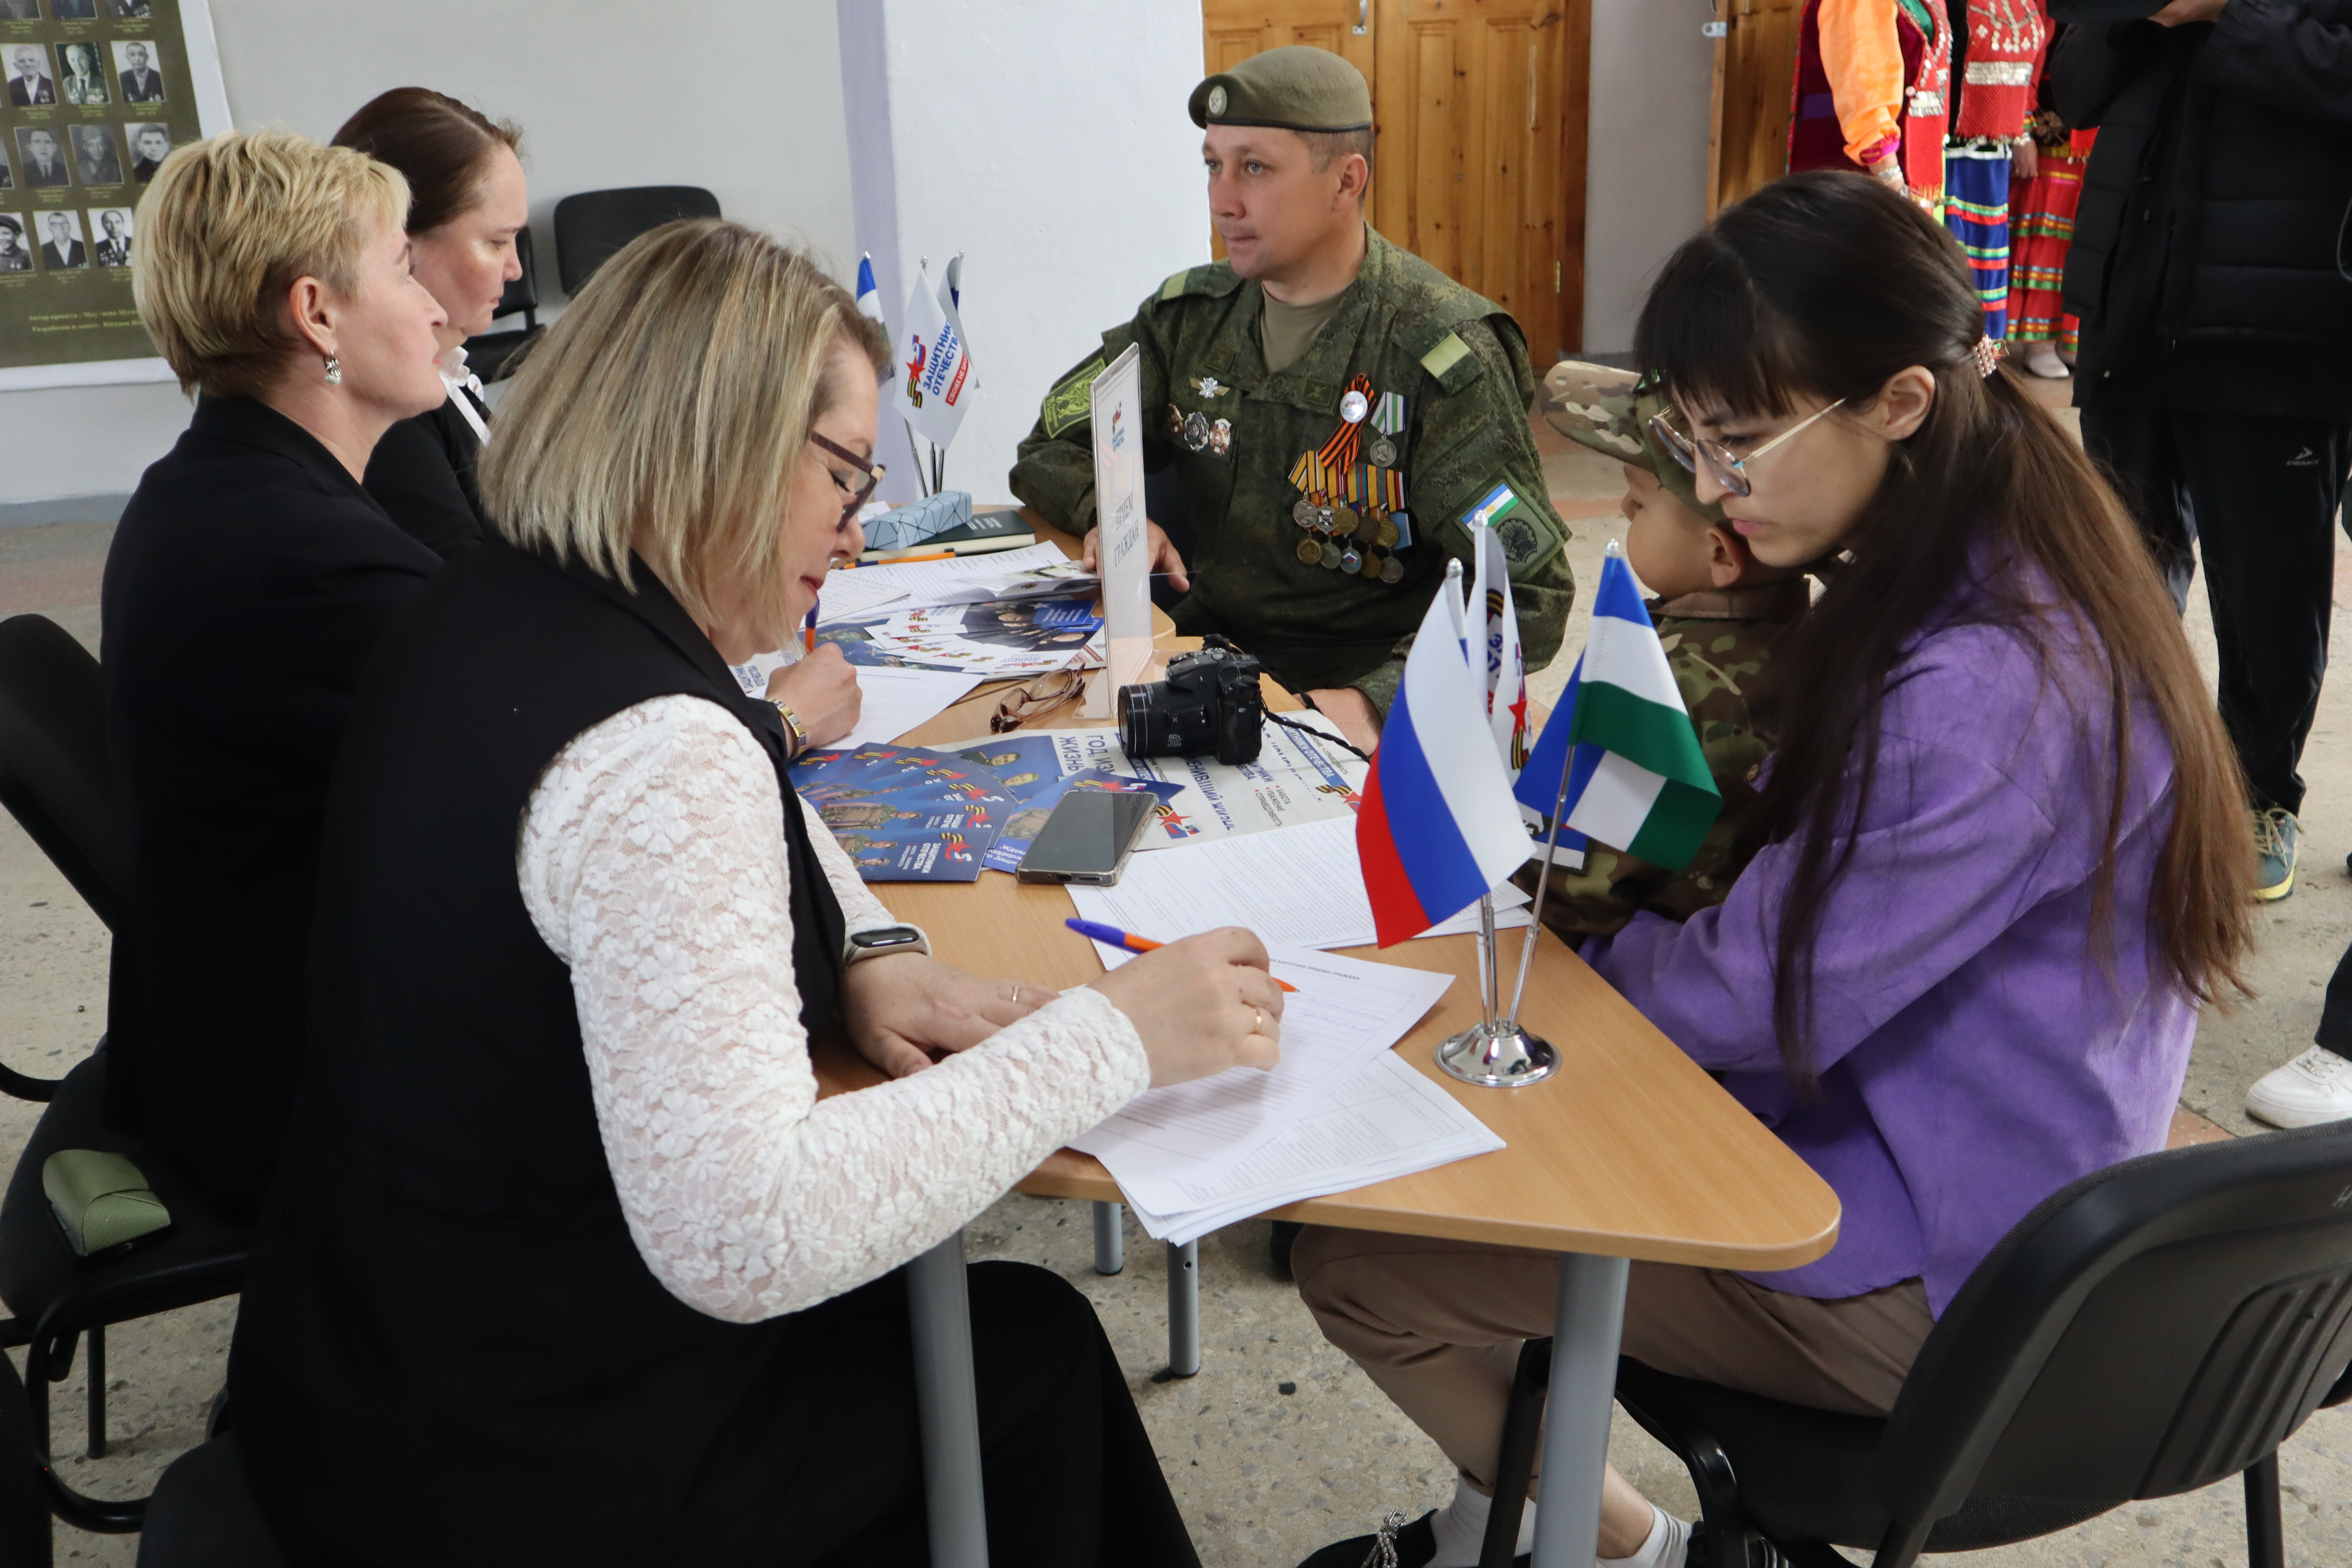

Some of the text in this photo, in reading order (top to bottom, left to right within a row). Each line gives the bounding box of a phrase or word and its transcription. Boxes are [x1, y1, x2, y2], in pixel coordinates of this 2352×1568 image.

[923, 321, 951, 390] ЗАЩИТНИК
[933, 334, 958, 396] ОТЕЧЕСТВ
[948, 380, 961, 402] СВОИХ
[957, 369, 965, 379] НЕ
[1116, 492, 1134, 531] ПРИЕМ
[1114, 519, 1139, 568] ГРАЖДАН
[1058, 736, 1085, 771] ЖИЗНЬ
[1304, 750, 1335, 778] ОТЕЧЕСТВА
[1185, 758, 1223, 801] ЕНИВШИЙ
[1276, 788, 1291, 805] ЗАБОТА
[1266, 789, 1285, 813] УВАЖЕНИЕ
[912, 842, 931, 870] ОТЕЧЕСТВА
[921, 842, 941, 873] ЗАЩИТНИКИ
